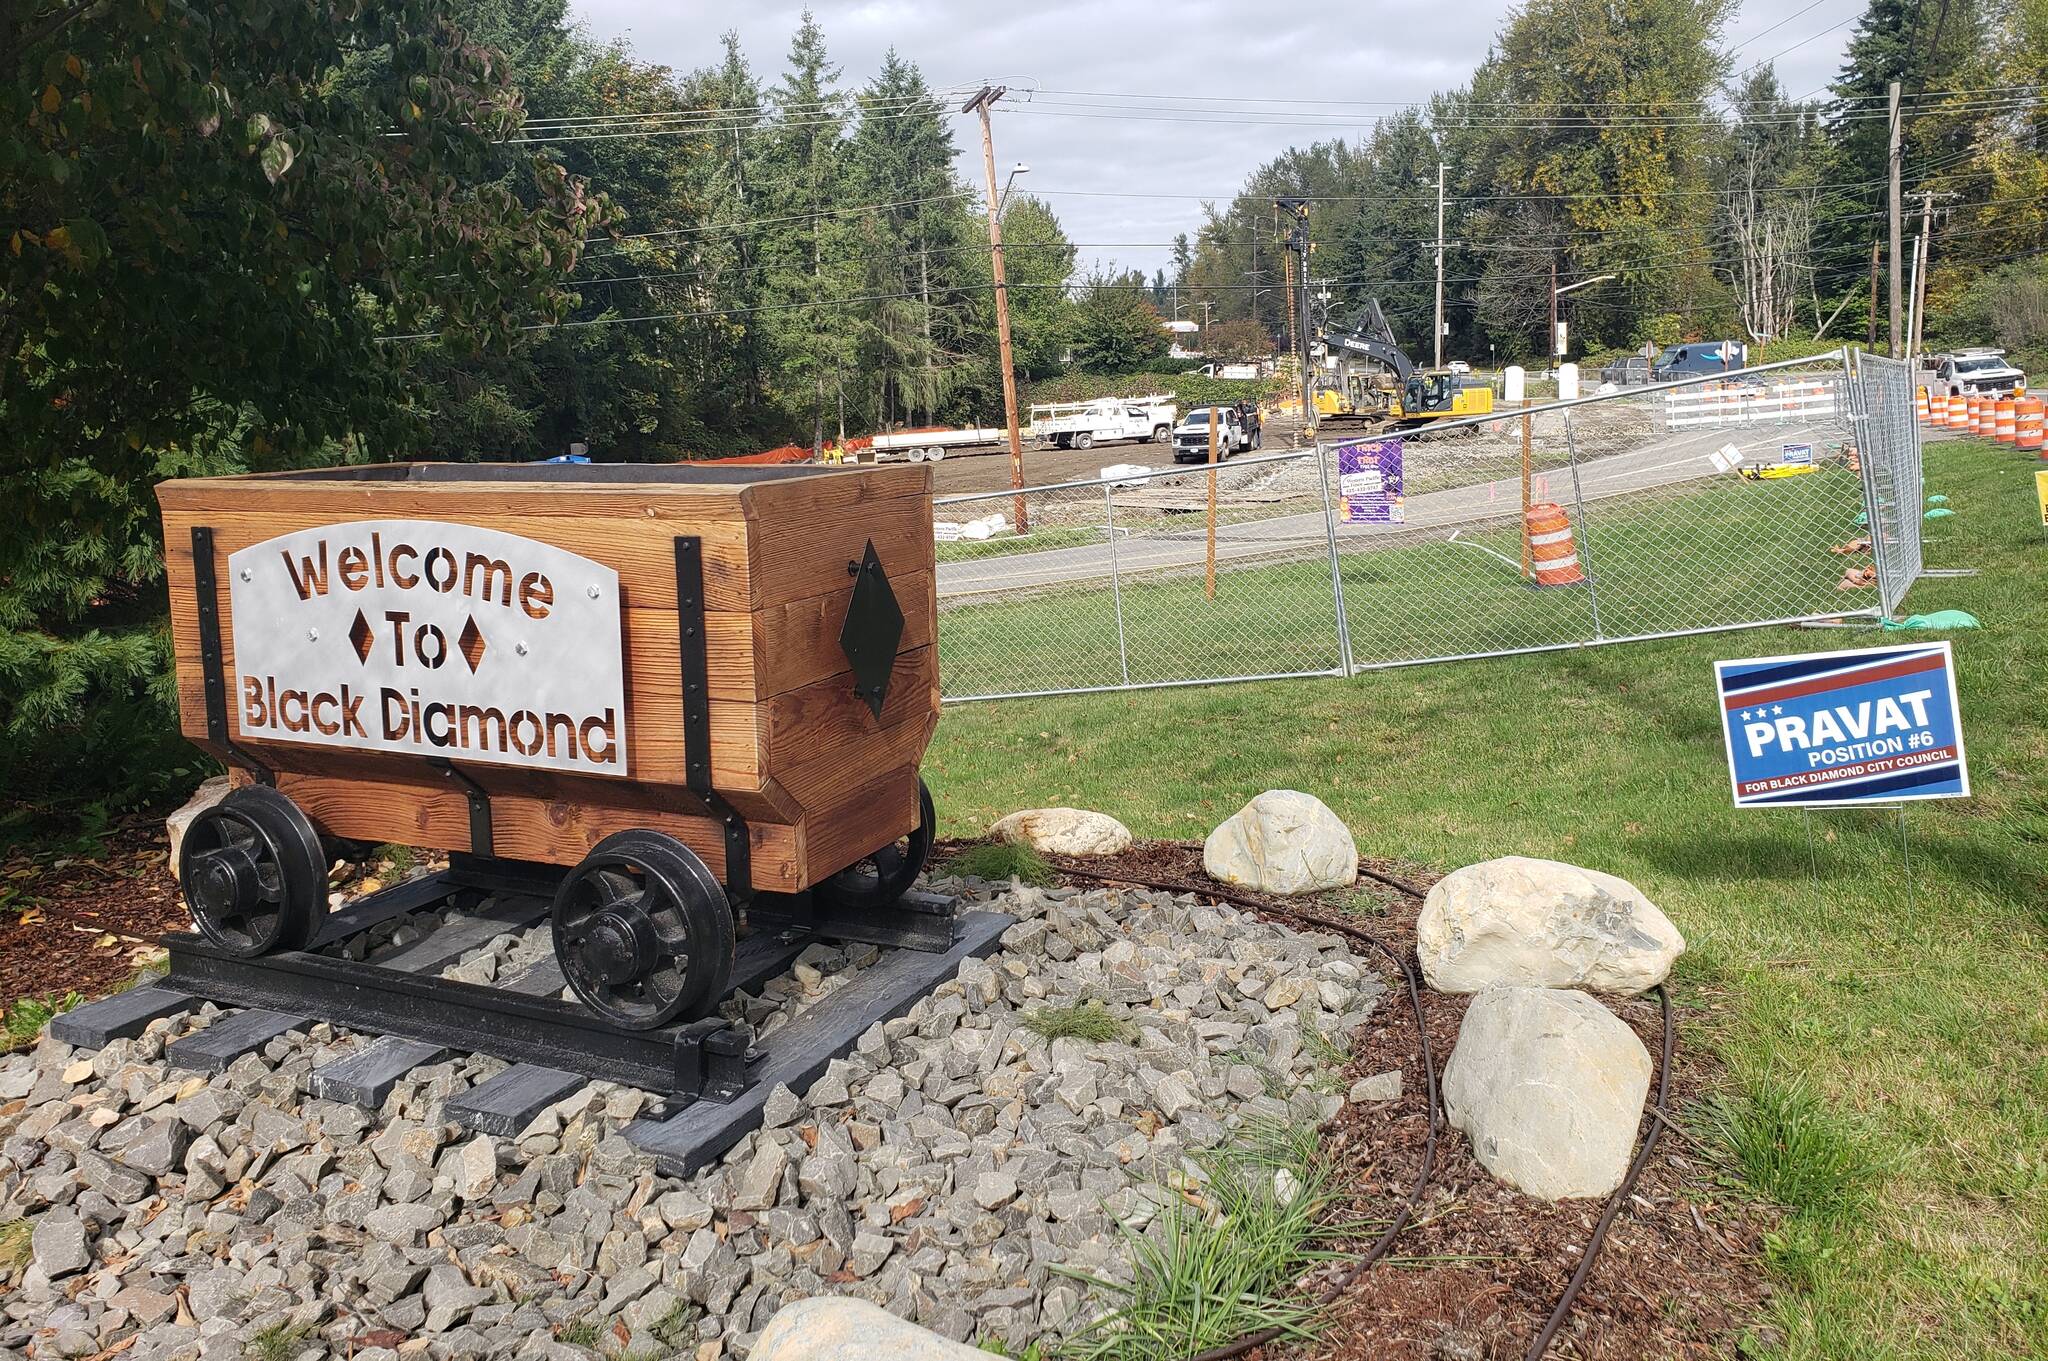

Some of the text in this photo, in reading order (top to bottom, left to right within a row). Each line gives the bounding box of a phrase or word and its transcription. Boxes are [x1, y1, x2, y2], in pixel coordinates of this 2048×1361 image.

[1344, 338, 1371, 351] DEERE
[280, 531, 555, 619] Welcome
[384, 610, 448, 669] To
[242, 675, 617, 764] Black Diamond
[1744, 689, 1932, 758] PRAVAT
[1808, 730, 1934, 768] POSITION #6
[1745, 749, 1952, 793] FOR BLACK DIAMOND CITY COUNCIL
